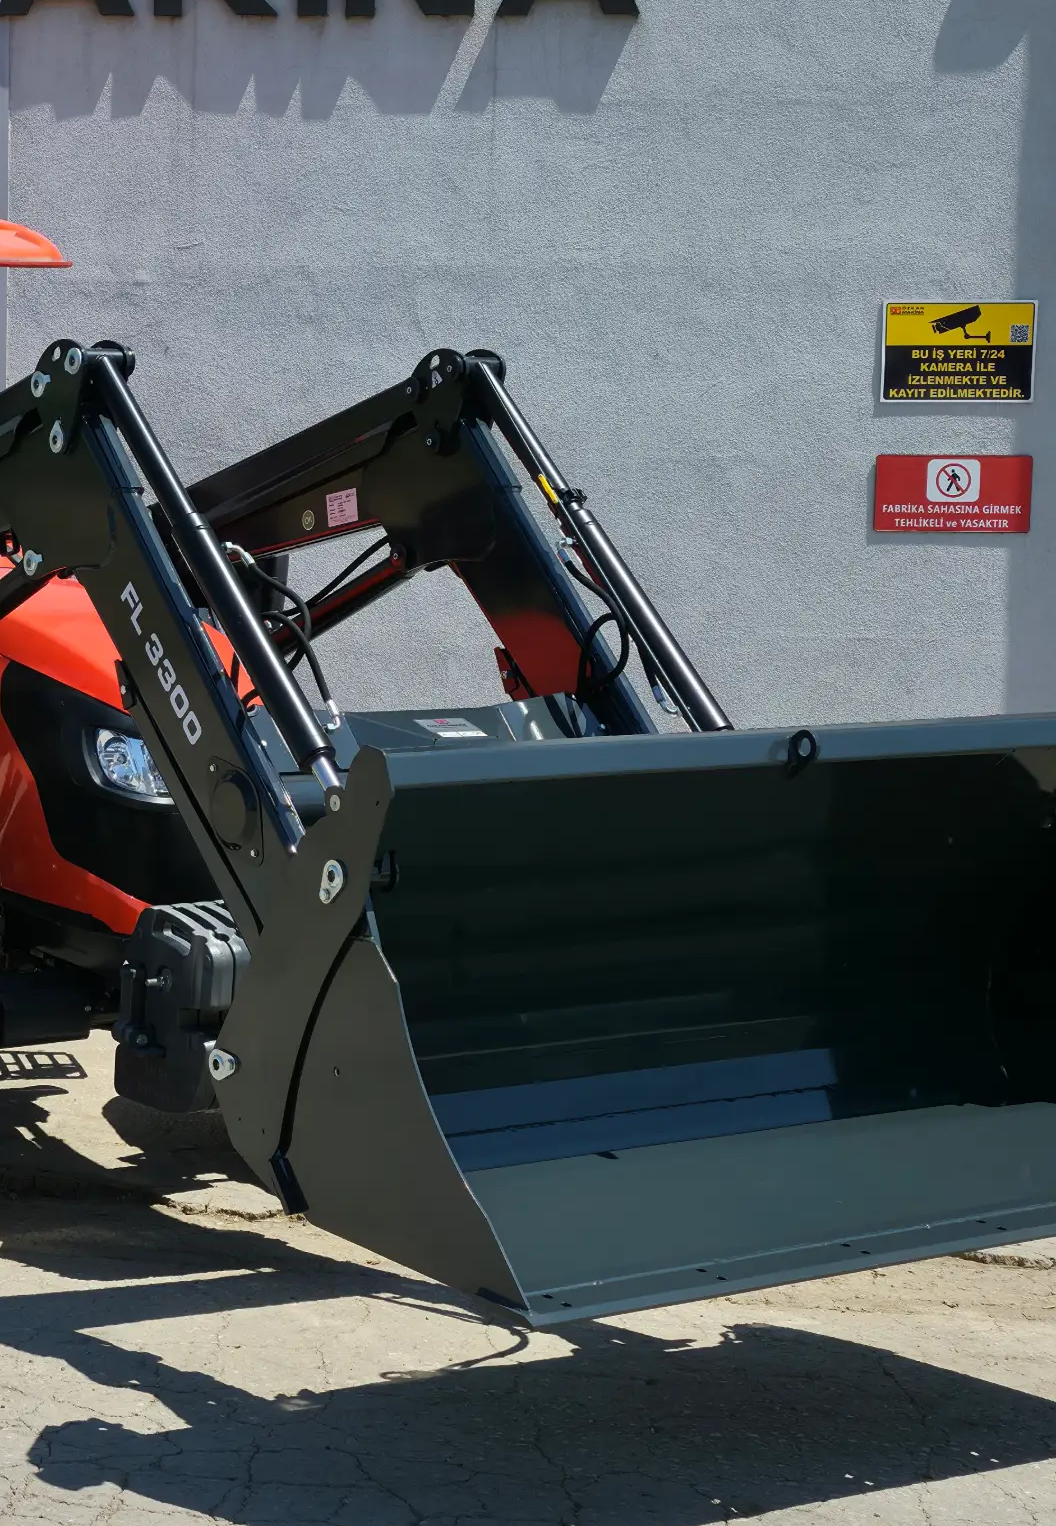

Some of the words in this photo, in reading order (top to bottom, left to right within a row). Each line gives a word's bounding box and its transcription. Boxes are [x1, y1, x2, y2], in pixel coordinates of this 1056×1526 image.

[911, 349, 929, 359] BU
[932, 347, 945, 361] İŞ
[947, 347, 977, 359] YERİ
[980, 349, 1006, 359] 7/24
[920, 362, 973, 372] KAMERA
[976, 361, 996, 372] İLE
[908, 373, 987, 385] İZLENMEKTE
[990, 375, 1007, 385] VE
[889, 388, 927, 398] KAYIT
[929, 386, 1025, 398] EDİLMEKTEDİR.
[882, 502, 925, 513] FABRİKA
[927, 504, 980, 514] SAHASINA
[982, 503, 1022, 514] GİRMEK
[894, 516, 944, 527] TEHLİKELİ
[946, 520, 957, 528] ve
[960, 519, 1009, 528] YASAKTIR
[120, 581, 144, 636] FL
[145, 632, 202, 745] 3300
